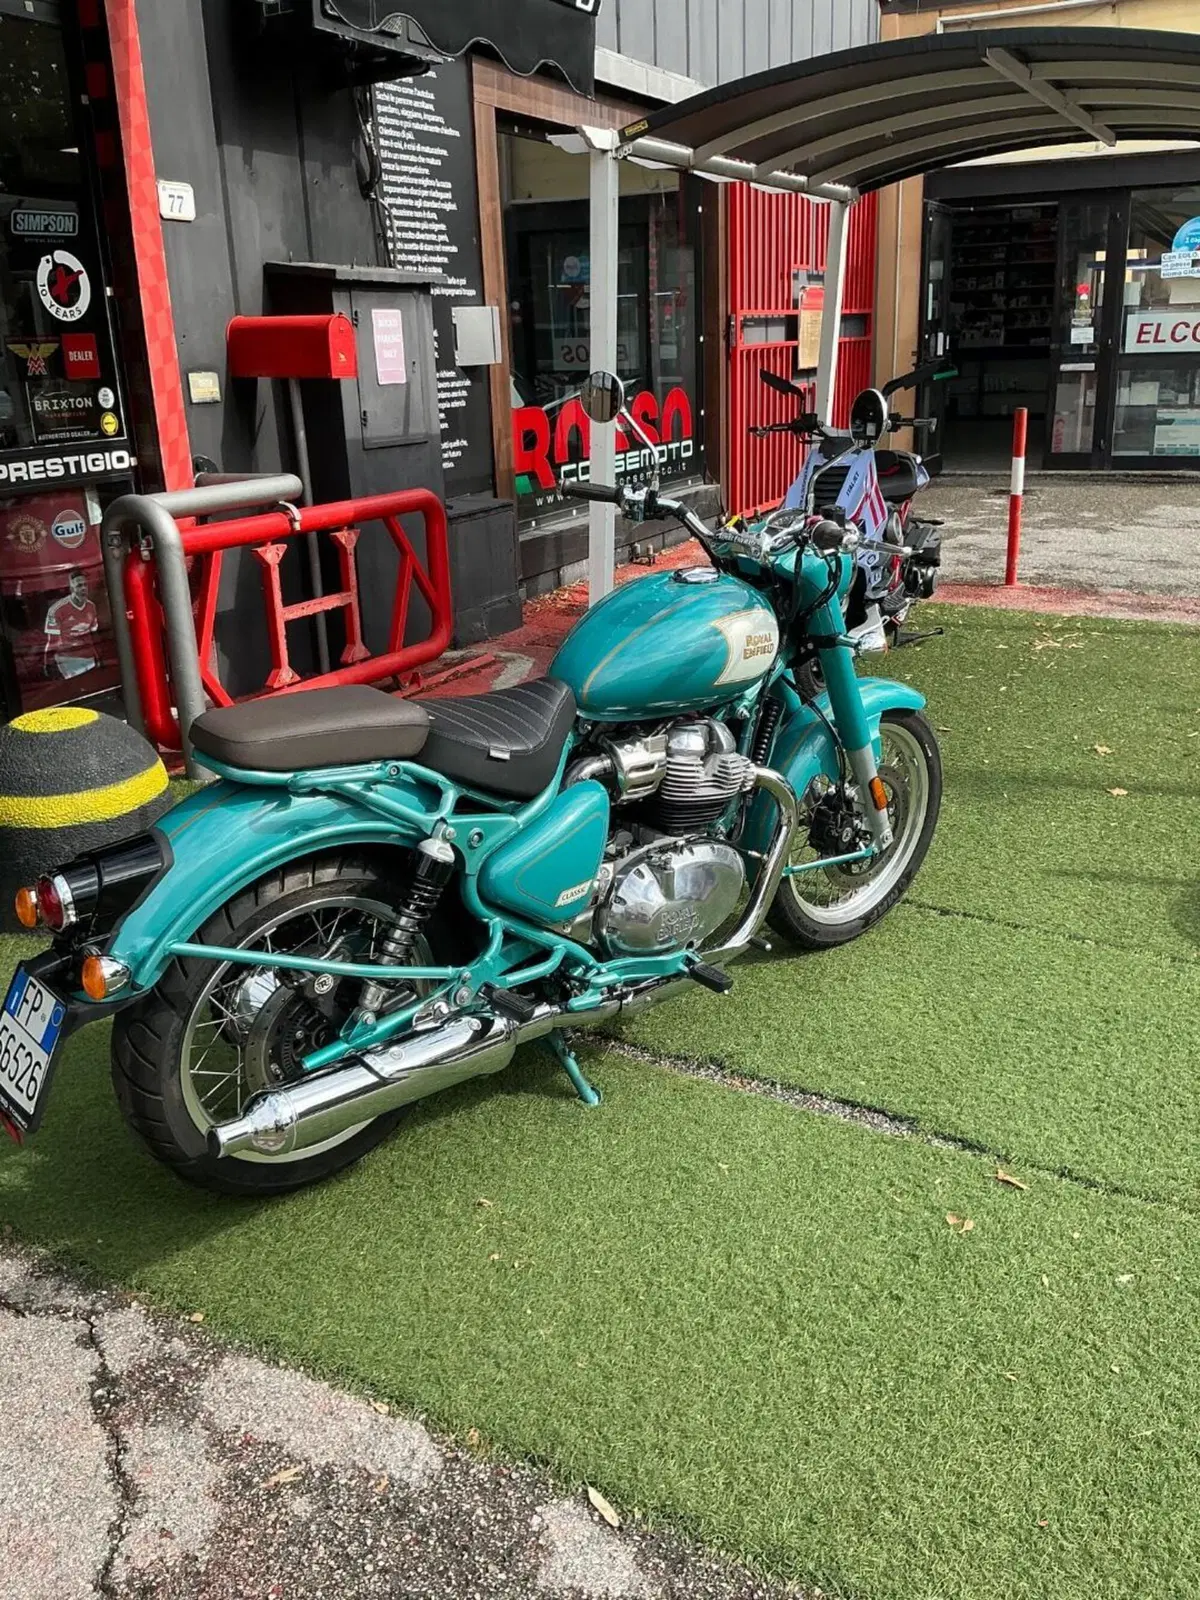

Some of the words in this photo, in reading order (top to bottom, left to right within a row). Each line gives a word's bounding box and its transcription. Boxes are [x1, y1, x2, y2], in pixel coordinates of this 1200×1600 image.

[168, 194, 184, 213] 77
[15, 213, 74, 232] SIMPSON
[39, 283, 48, 297] 10
[48, 300, 82, 319] YEARS
[68, 351, 94, 362] DEALER
[34, 396, 93, 412] BRIXTON
[37, 432, 70, 441] AUTHORIZED
[70, 430, 91, 438] DEALER
[560, 440, 693, 484] COSEMOTO
[845, 471, 861, 497] ITALJET
[55, 522, 85, 536] Gulf
[745, 632, 772, 647] ROYAL
[743, 643, 775, 660] ENFIELD
[561, 886, 586, 901] CLASSIC
[16, 979, 43, 1027] FP
